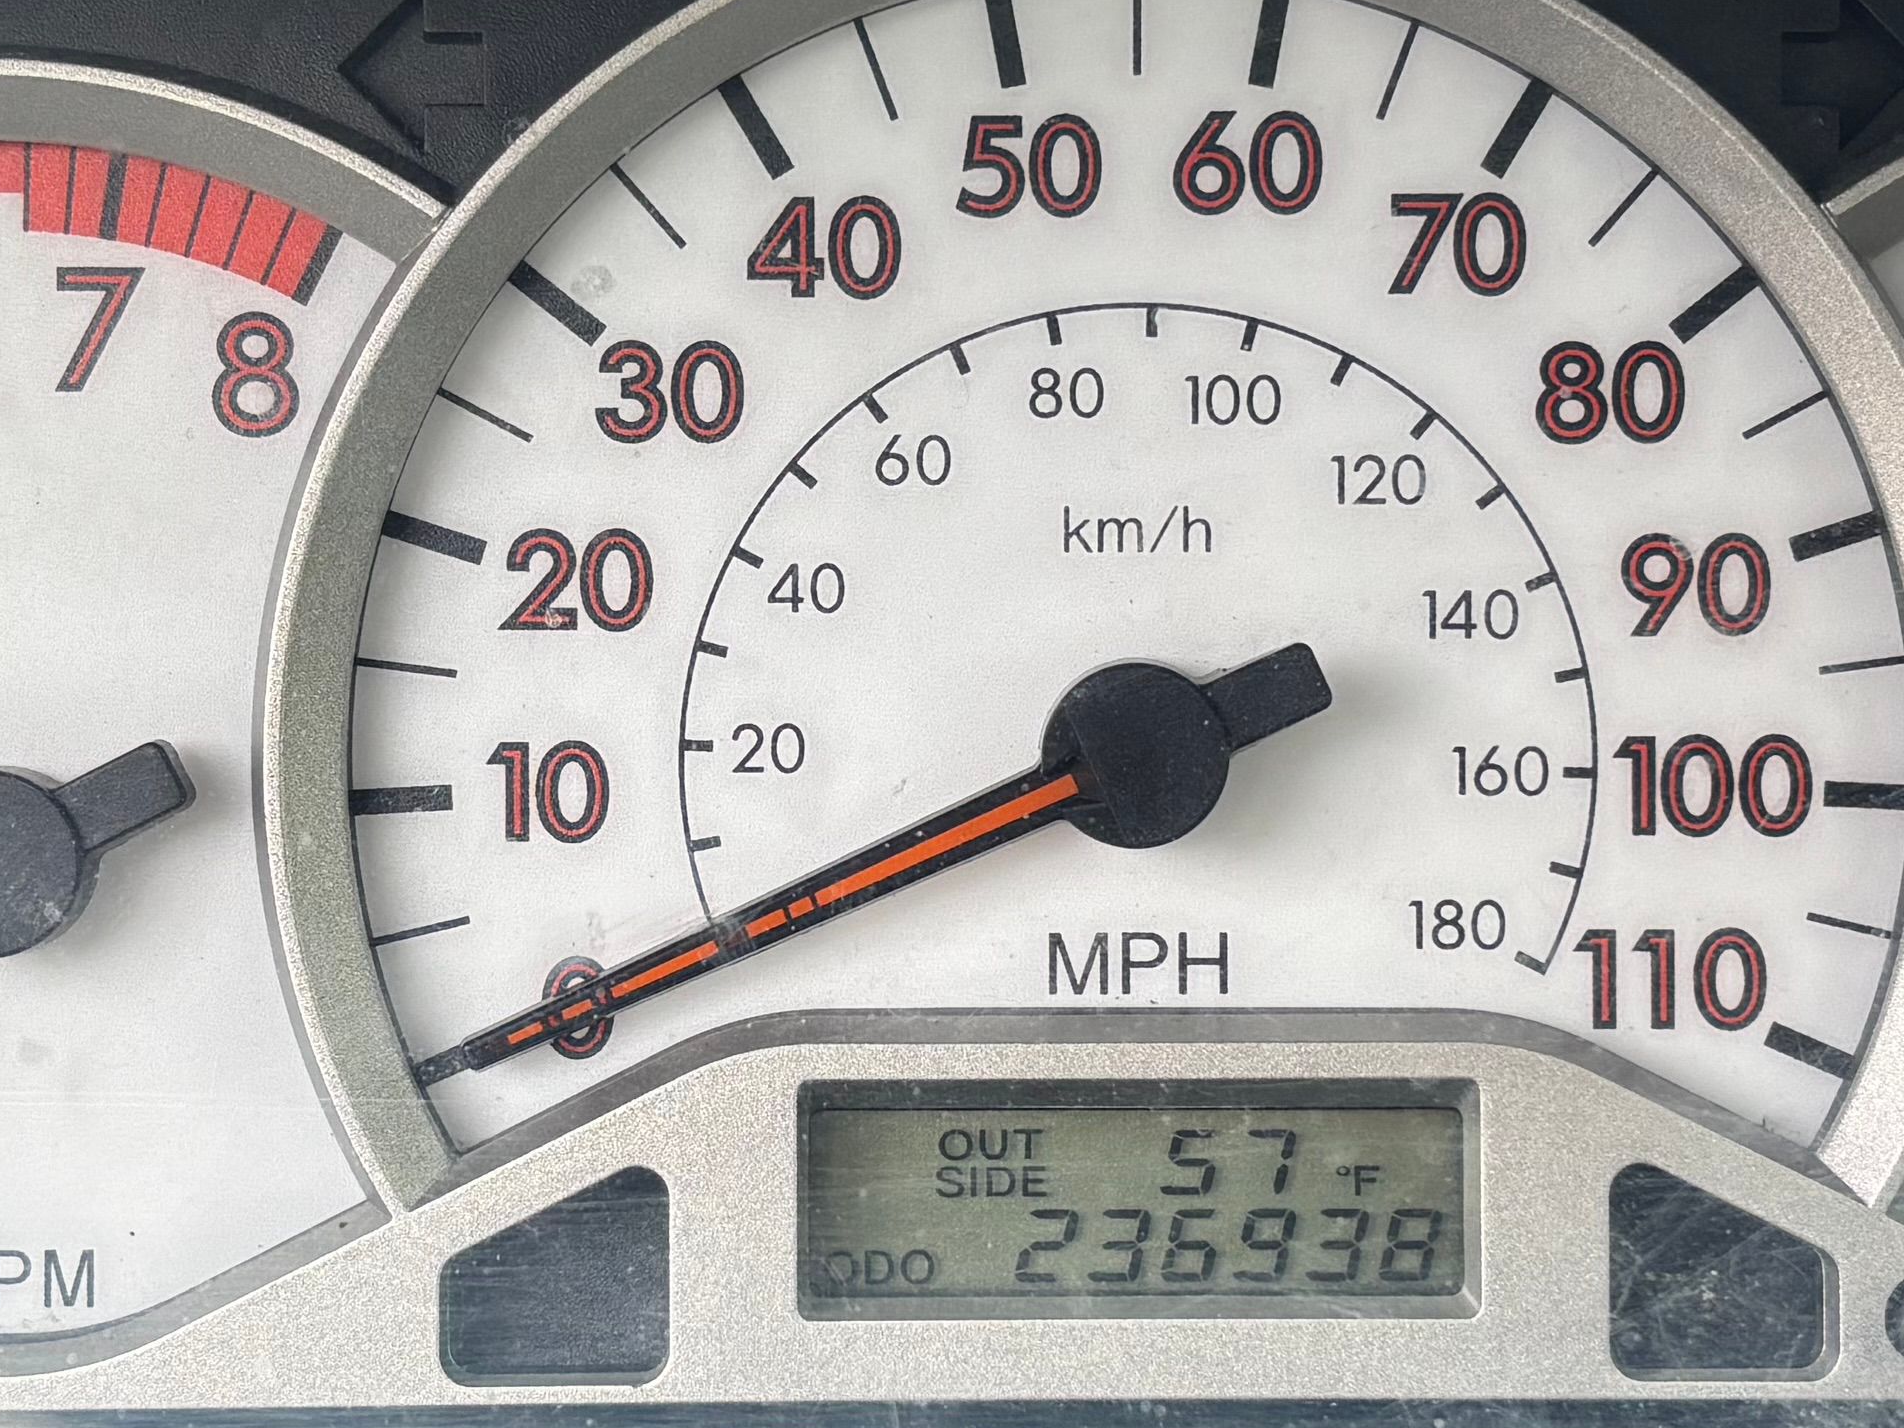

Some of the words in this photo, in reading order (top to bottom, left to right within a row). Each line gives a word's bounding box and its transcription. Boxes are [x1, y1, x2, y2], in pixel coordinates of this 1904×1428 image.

[956, 114, 1101, 219] 50
[1173, 111, 1323, 216] 60
[747, 195, 901, 300] 40
[1388, 193, 1526, 297] 70
[55, 266, 145, 392] 7
[212, 312, 300, 437] 8
[594, 340, 743, 444] 30
[1029, 368, 1104, 419] 80
[1189, 374, 1281, 426] 100
[1535, 341, 1685, 445] 80
[875, 434, 951, 486] 60
[1332, 454, 1425, 506] 120
[1062, 506, 1211, 558] km/h
[497, 527, 654, 633] 20
[766, 562, 845, 614] 40
[1422, 589, 1518, 640] 140
[1621, 532, 1771, 637] 90
[731, 723, 805, 775] 20
[1452, 745, 1549, 796] 160
[1613, 733, 1813, 838] 100
[486, 739, 610, 843] 10
[1048, 931, 1230, 996] MPH
[1408, 899, 1505, 951] 180
[542, 956, 610, 1059] 0
[1573, 926, 1767, 1033] 110
[936, 1166, 1047, 1198] SIDE
[938, 1129, 1045, 1161] OUT
[1160, 1129, 1295, 1196] 57
[824, 1249, 935, 1286] ODO
[1015, 1208, 1443, 1284] 236938
